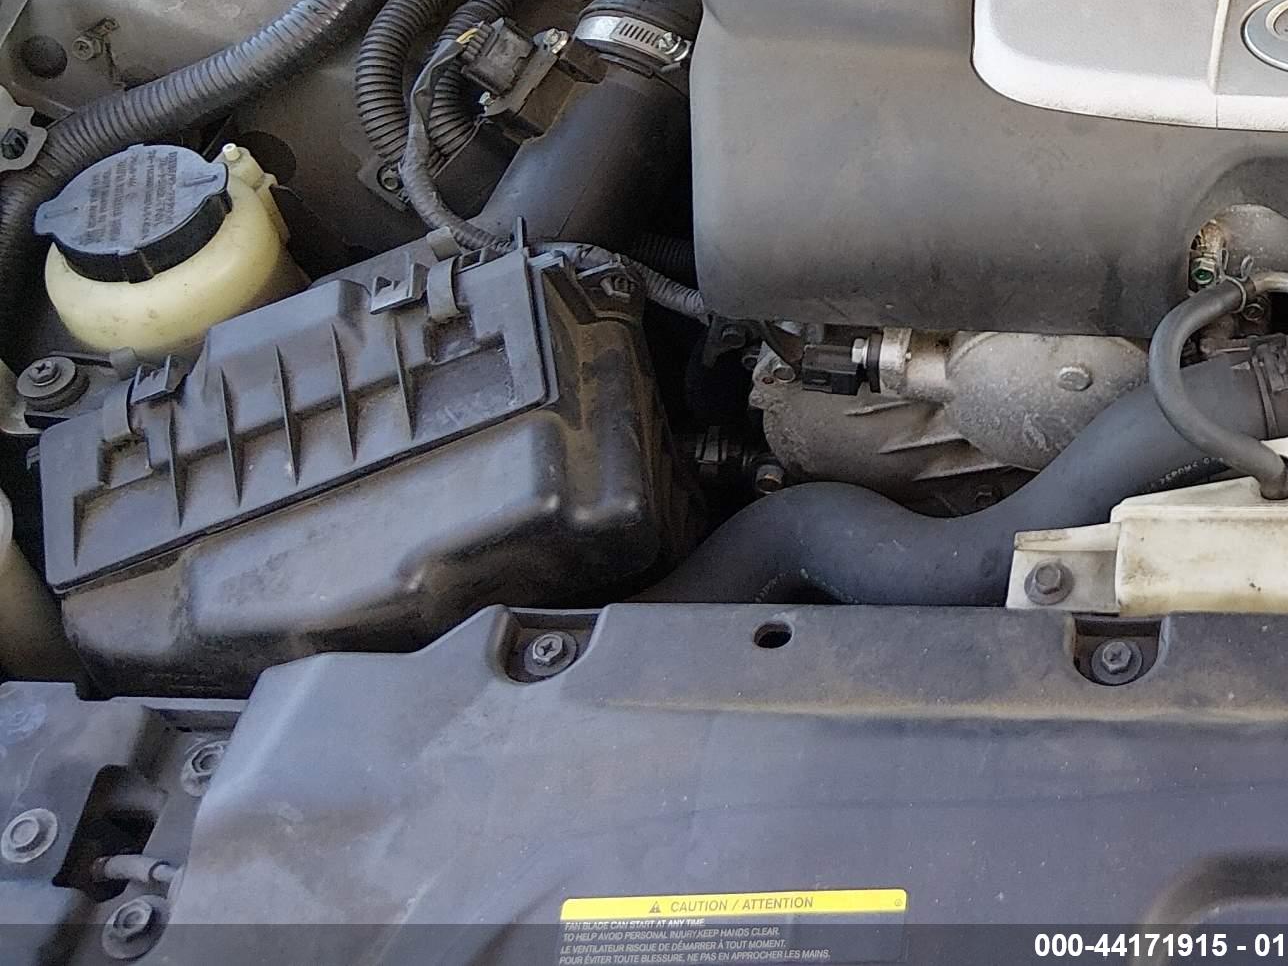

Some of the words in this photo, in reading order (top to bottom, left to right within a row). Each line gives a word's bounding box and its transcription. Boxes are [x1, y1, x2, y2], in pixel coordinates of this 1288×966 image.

[671, 900, 728, 912] CAUTION
[732, 900, 739, 912] /
[742, 897, 814, 910] ATTENTION
[609, 921, 629, 929] CAN
[630, 920, 656, 929] START
[657, 920, 665, 928] AT
[668, 920, 685, 928] ANY
[563, 933, 574, 942] TO
[576, 933, 597, 941] HELP
[598, 932, 623, 940] AVOID
[624, 931, 668, 940] PERSONAL
[721, 928, 749, 936] HANDS
[561, 945, 571, 954] LE
[573, 944, 625, 954] VENTILATEUR
[626, 942, 656, 952] RISQUE
[659, 942, 669, 951] DE
[671, 939, 716, 951] DÉMARRER
[726, 940, 747, 948] TOUT
[748, 939, 786, 948] MOMENT.
[560, 956, 584, 965] POUR
[584, 953, 612, 964] ÉVITER
[614, 955, 639, 963] TOUTE
[687, 953, 699, 961] NE
[700, 952, 716, 961] PAS
[718, 952, 730, 961] EN
[731, 950, 783, 960] APPROCHER
[784, 950, 800, 958] LES
[802, 949, 831, 958] MAINS.
